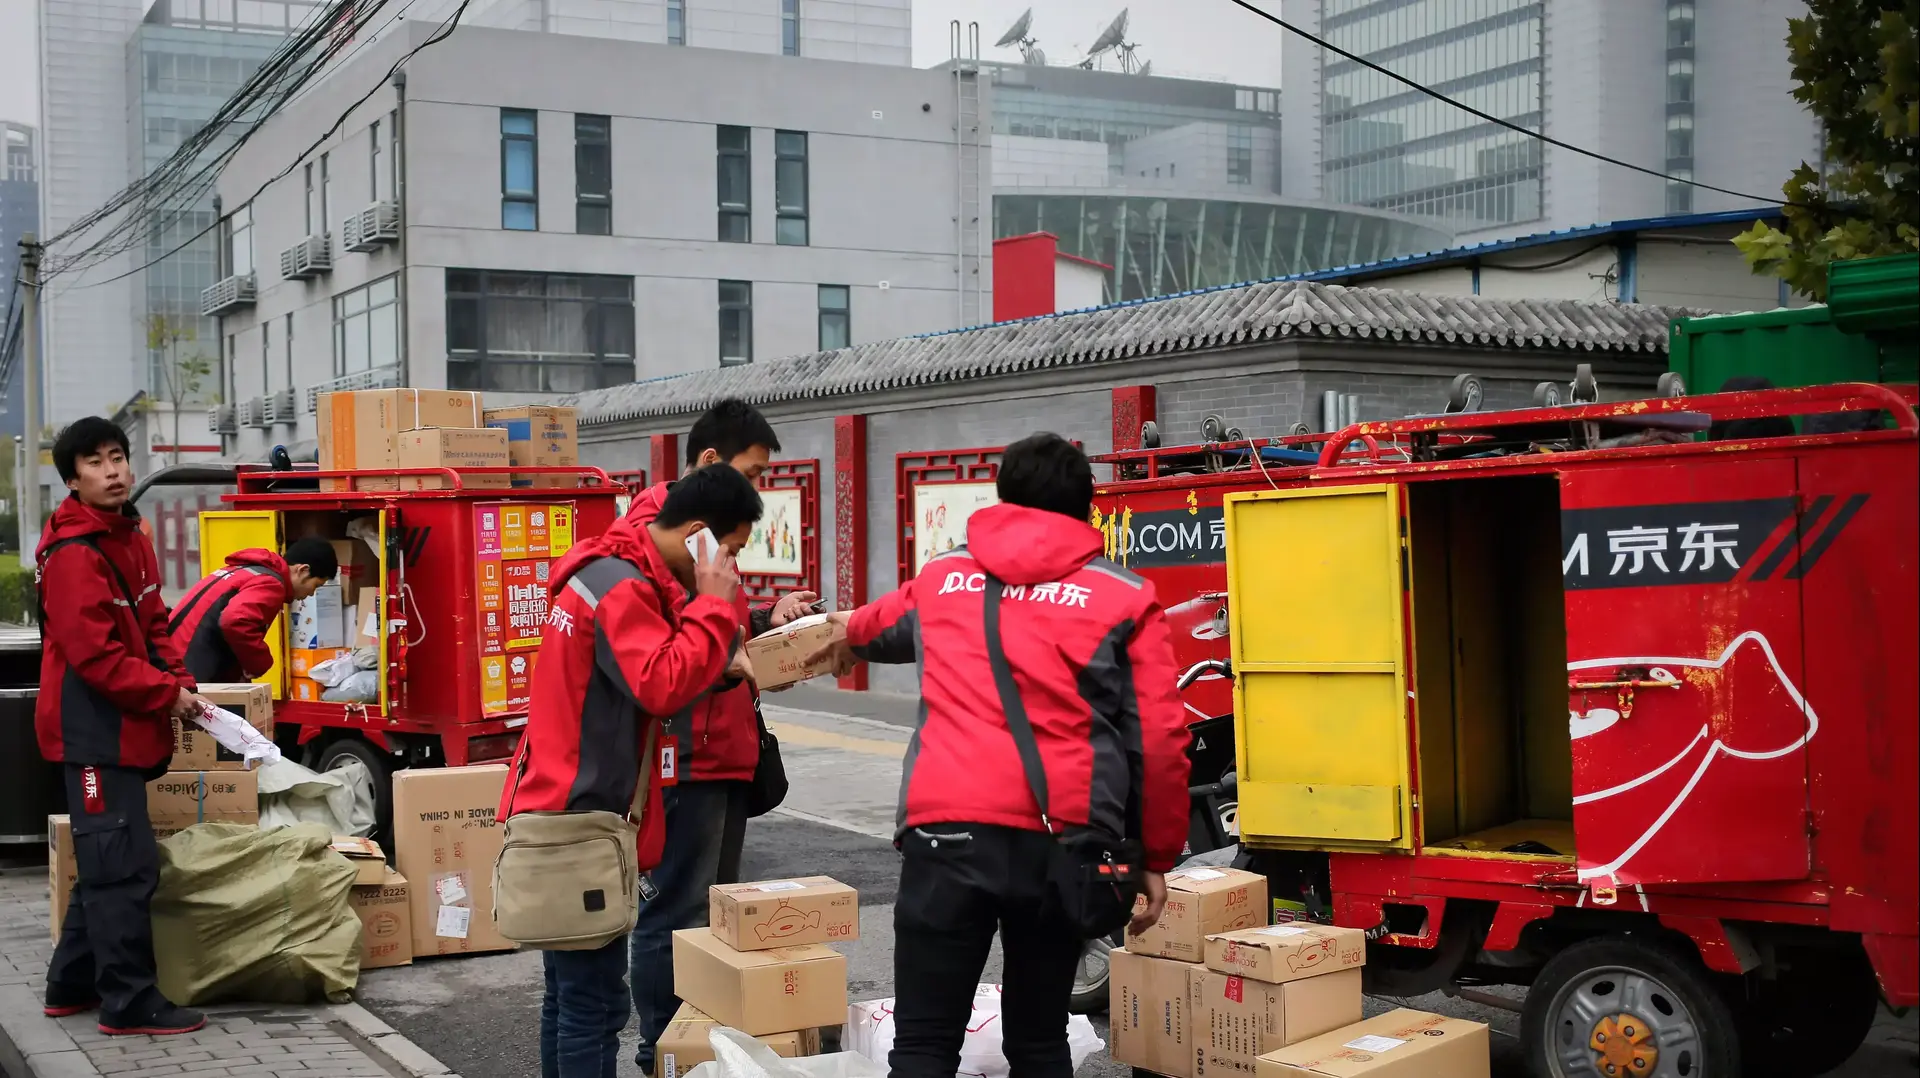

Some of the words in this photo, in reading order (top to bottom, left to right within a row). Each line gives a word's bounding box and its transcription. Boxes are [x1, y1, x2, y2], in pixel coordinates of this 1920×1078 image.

[1108, 522, 1202, 556] D.COM
[1607, 523, 1740, 576] 京东
[1031, 583, 1092, 608] 京东
[509, 599, 548, 615] 同是低价
[510, 613, 549, 628] 爽购11天
[548, 605, 573, 637] 京东
[85, 772, 97, 798] 京东
[420, 811, 450, 822] CHINA
[454, 810, 464, 819] IN
[468, 807, 496, 819] MADE
[383, 887, 406, 897] 8225
[1167, 901, 1186, 912] 京东
